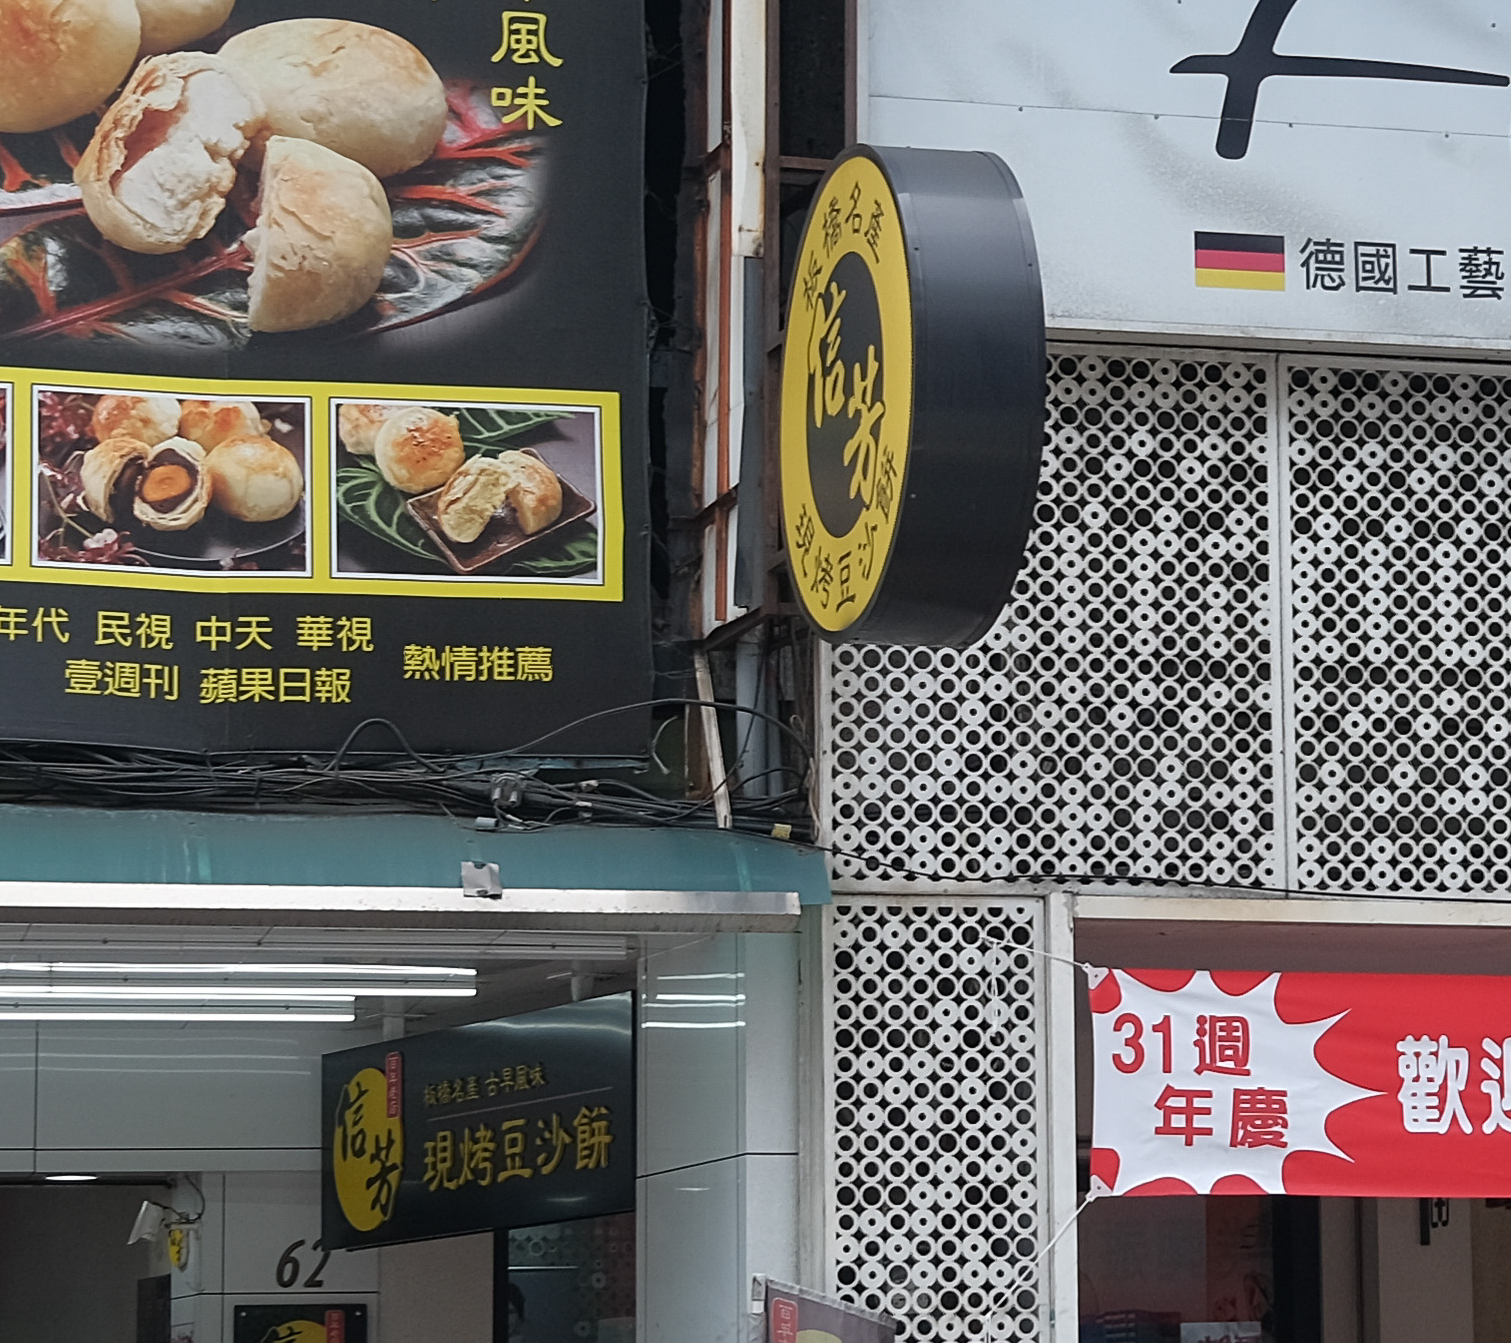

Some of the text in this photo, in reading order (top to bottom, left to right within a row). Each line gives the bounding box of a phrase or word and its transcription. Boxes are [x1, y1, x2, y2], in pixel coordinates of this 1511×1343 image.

[802, 181, 886, 311] 板橋名產
[1300, 238, 1506, 300] 德國工藝
[808, 282, 885, 510] 信芳
[93, 610, 173, 651] 民視
[194, 616, 273, 653] 中天
[296, 614, 374, 654] 華視
[64, 659, 180, 701] 壹週刊
[198, 667, 352, 707] 蘋果日報
[402, 645, 553, 684] 熱情推薦
[1113, 1014, 1252, 1078] 31週
[422, 1105, 614, 1193] 現烤豆沙餅
[1153, 1084, 1289, 1150] 年慶
[337, 1084, 403, 1221] 信芳
[275, 1238, 330, 1288] 62
